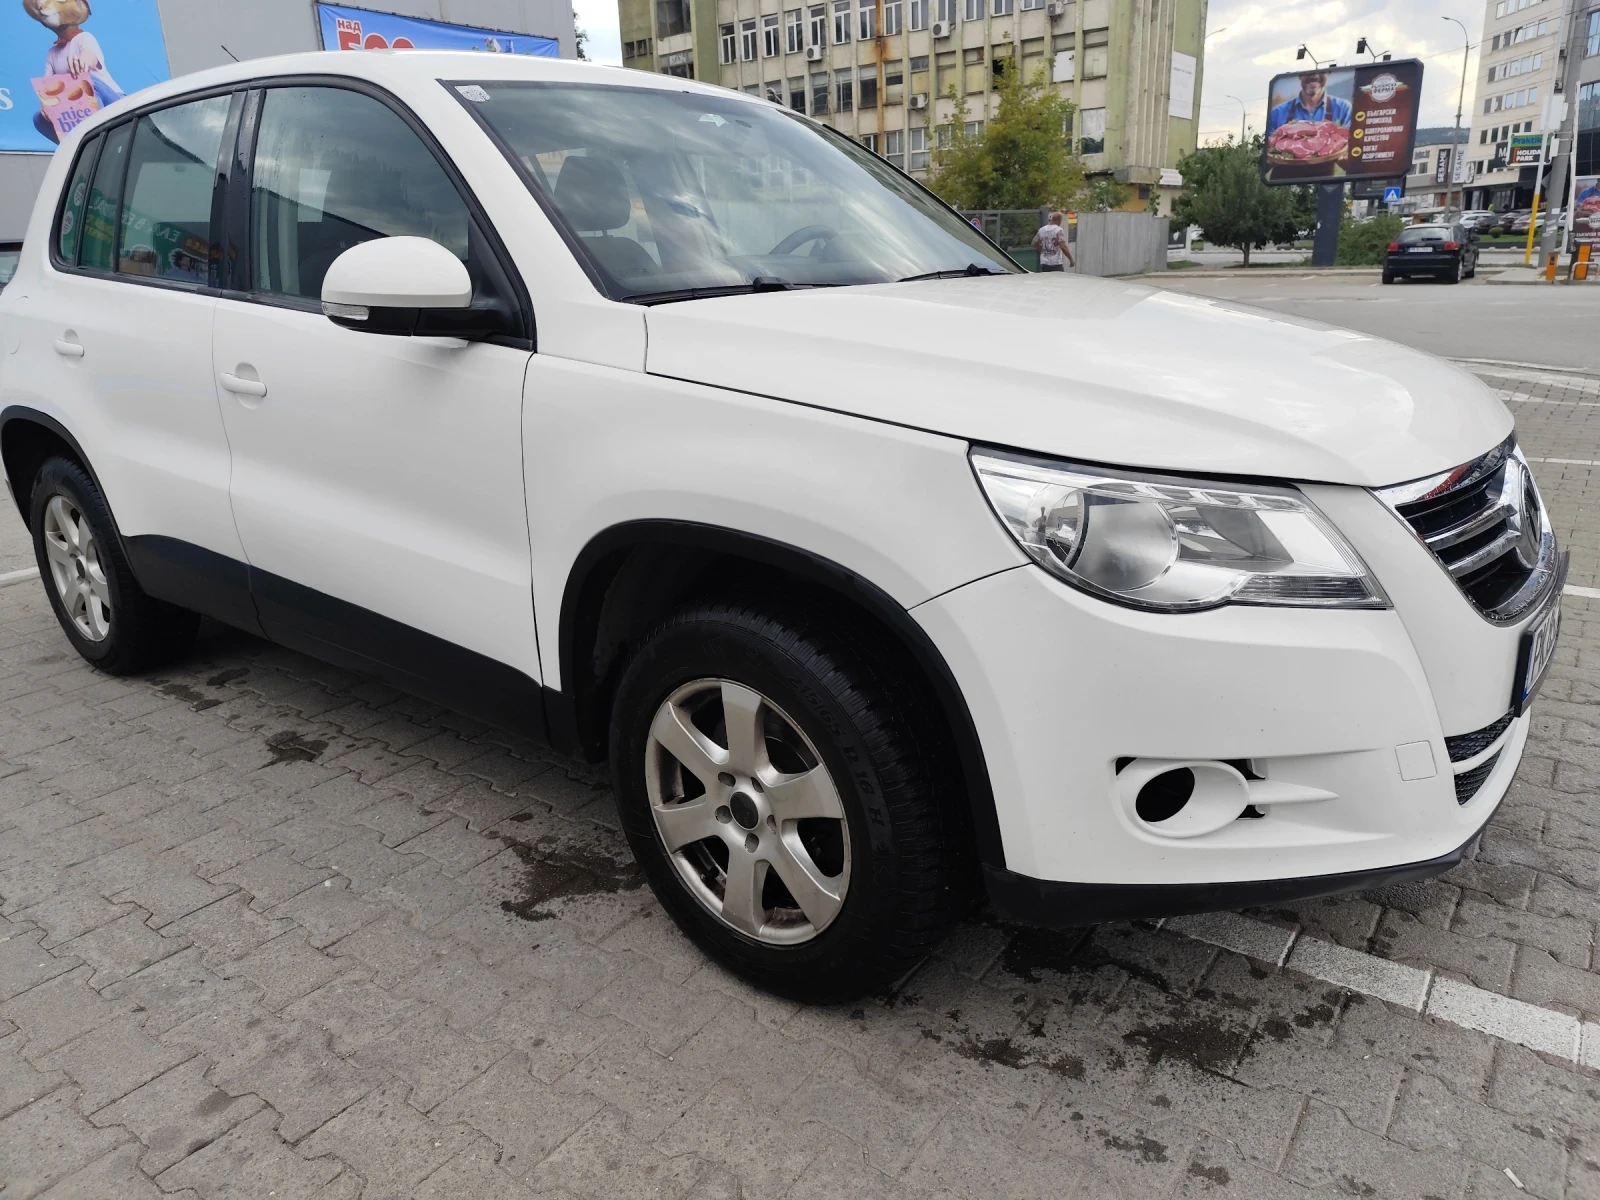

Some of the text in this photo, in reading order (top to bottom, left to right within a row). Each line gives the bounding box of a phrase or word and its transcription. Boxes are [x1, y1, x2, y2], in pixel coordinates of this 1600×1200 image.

[337, 19, 362, 34] над
[60, 106, 92, 121] nice
[1438, 150, 1447, 183] SESAME
[1454, 150, 1464, 181] SESAME
